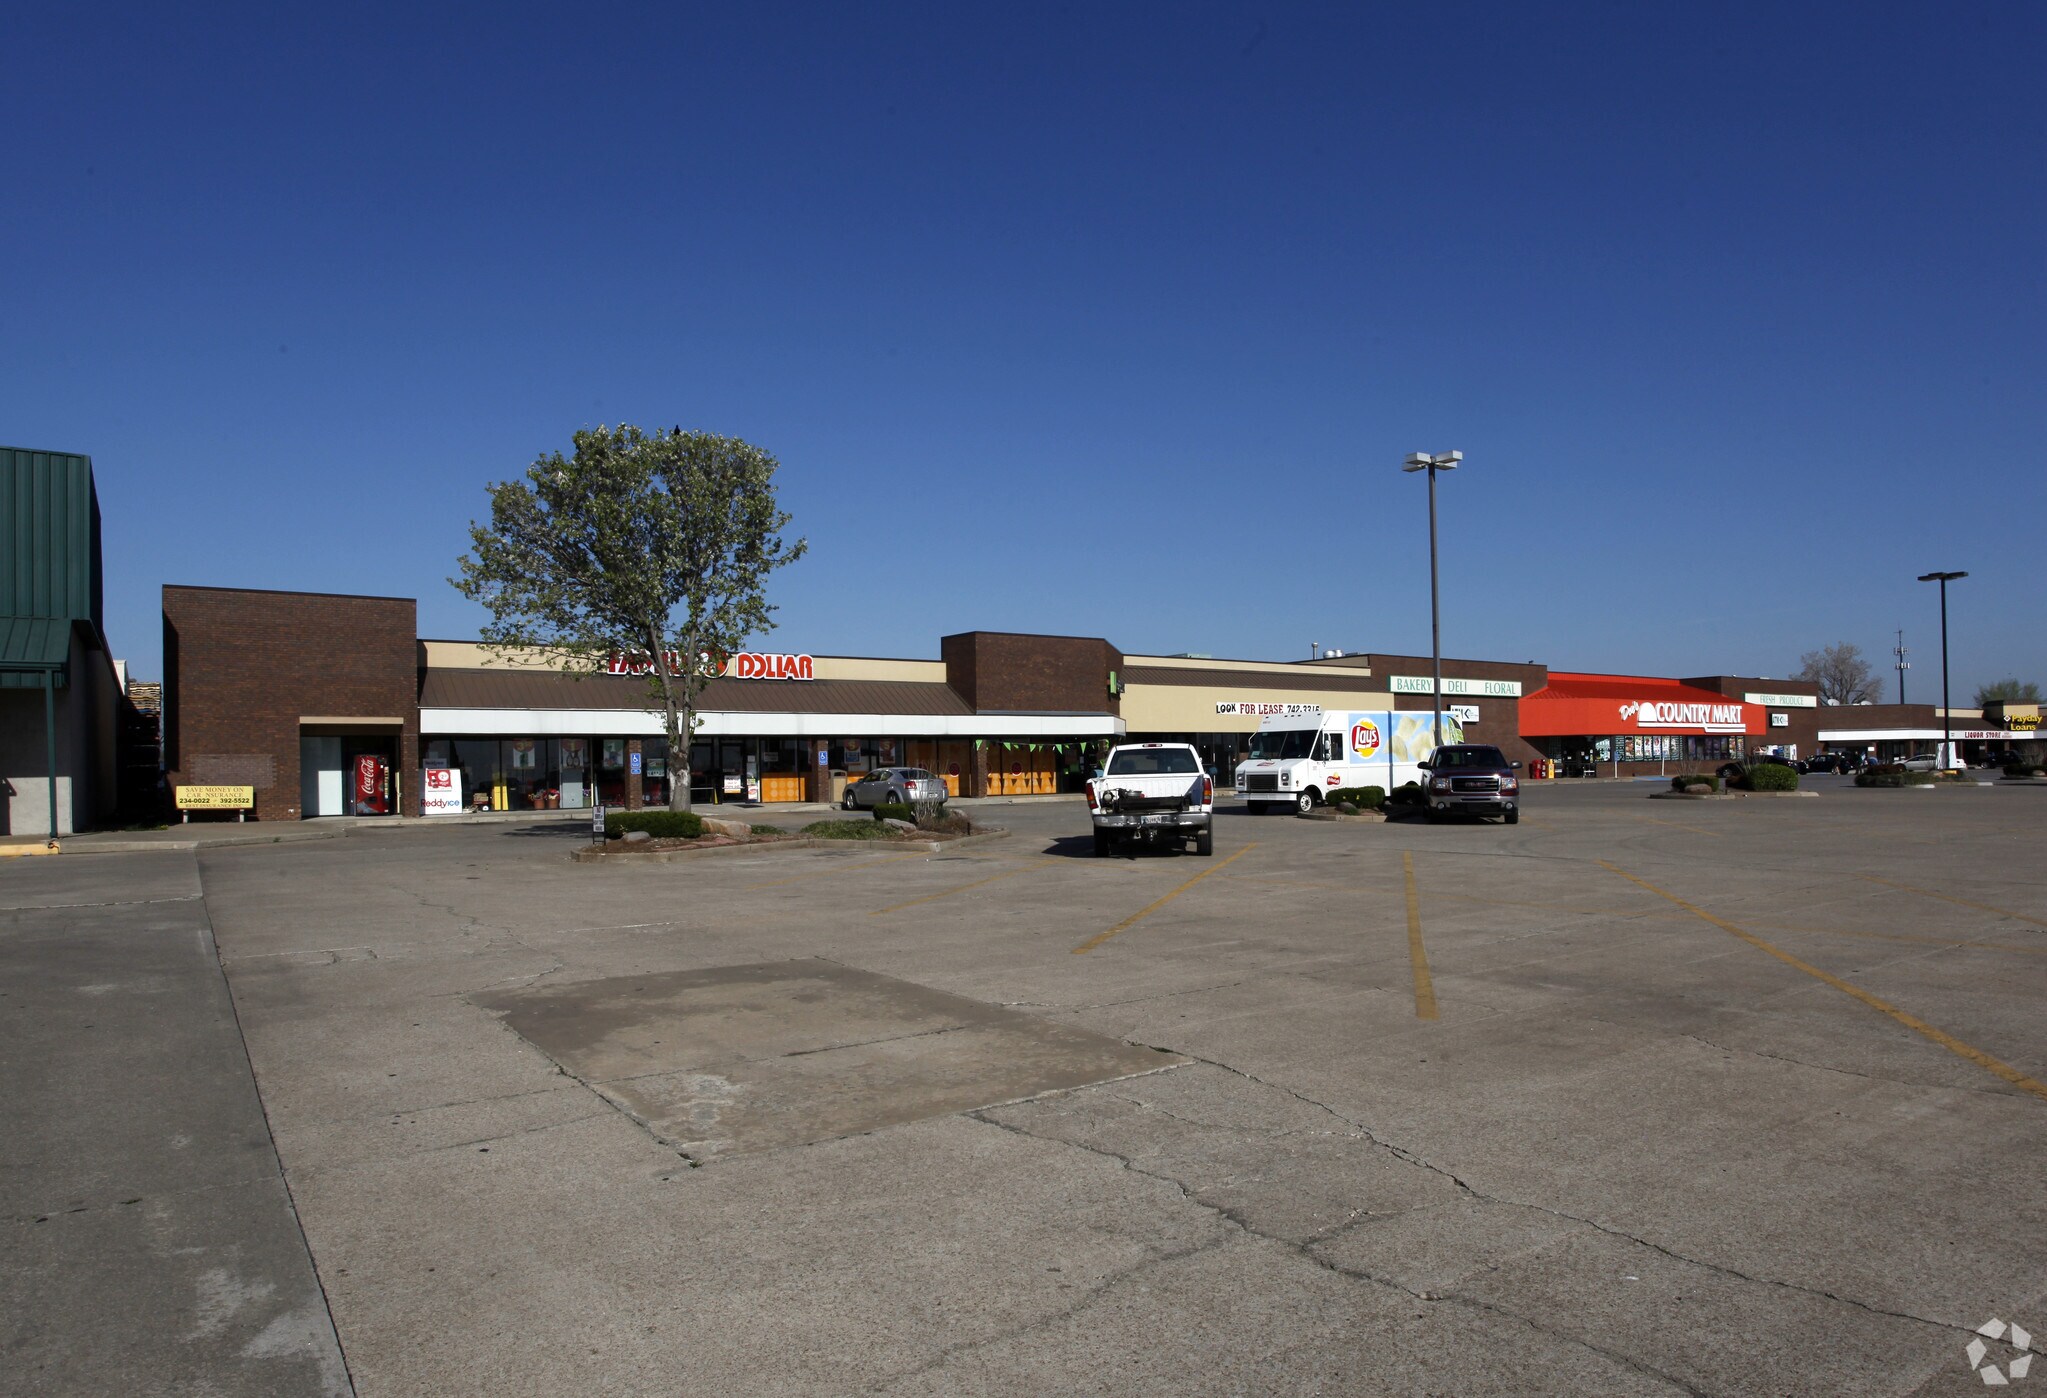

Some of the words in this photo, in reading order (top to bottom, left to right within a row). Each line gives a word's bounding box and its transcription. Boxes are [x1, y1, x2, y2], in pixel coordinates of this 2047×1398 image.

[737, 654, 812, 679] DOLLAR
[1396, 678, 1432, 691] BAKERY
[1448, 680, 1467, 692] DELI
[1484, 682, 1516, 694] FLORAL
[1760, 695, 1775, 704] FRESH
[1779, 696, 1804, 705] PRODUCE
[1216, 703, 1236, 713] LOOK
[1240, 704, 1255, 714] FOR
[1258, 704, 1283, 714] LEASE
[1655, 702, 1711, 723] COUNTRY
[1712, 704, 1742, 723] MART
[2011, 715, 2042, 724] Payday
